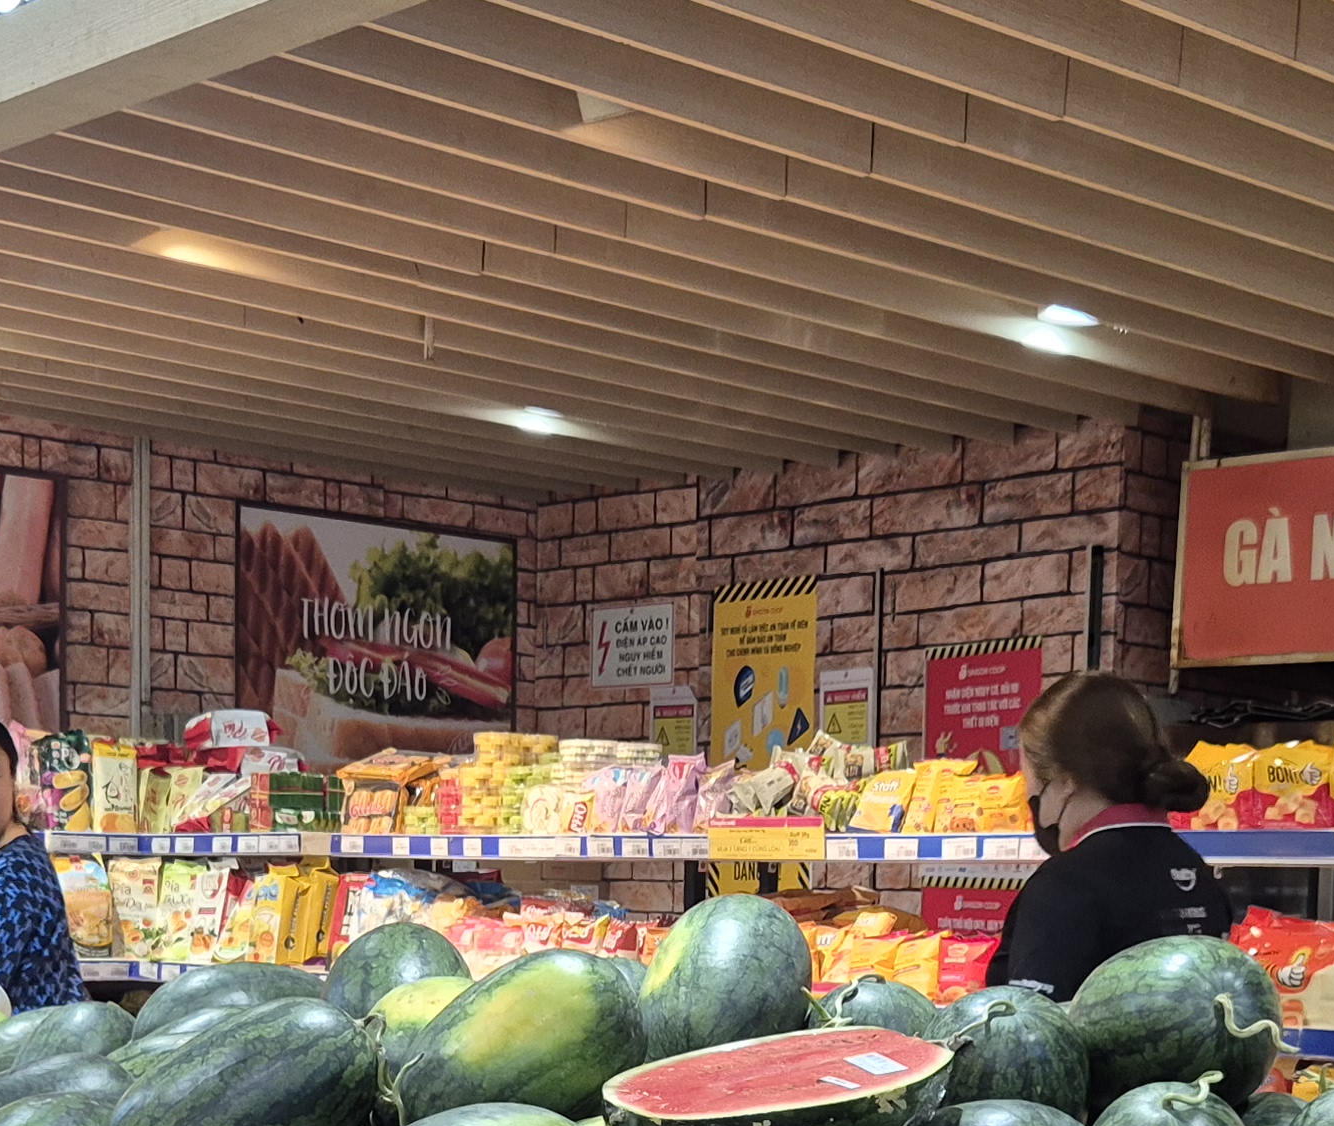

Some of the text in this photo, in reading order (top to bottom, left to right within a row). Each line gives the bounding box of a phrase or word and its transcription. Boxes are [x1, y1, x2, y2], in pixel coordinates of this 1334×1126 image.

[1223, 507, 1292, 587] GÀ
[614, 616, 638, 634] CẤM
[641, 615, 663, 631] VÀO
[649, 634, 667, 646] CAO
[618, 652, 640, 662] NGUY
[380, 652, 428, 701] ĐÁO
